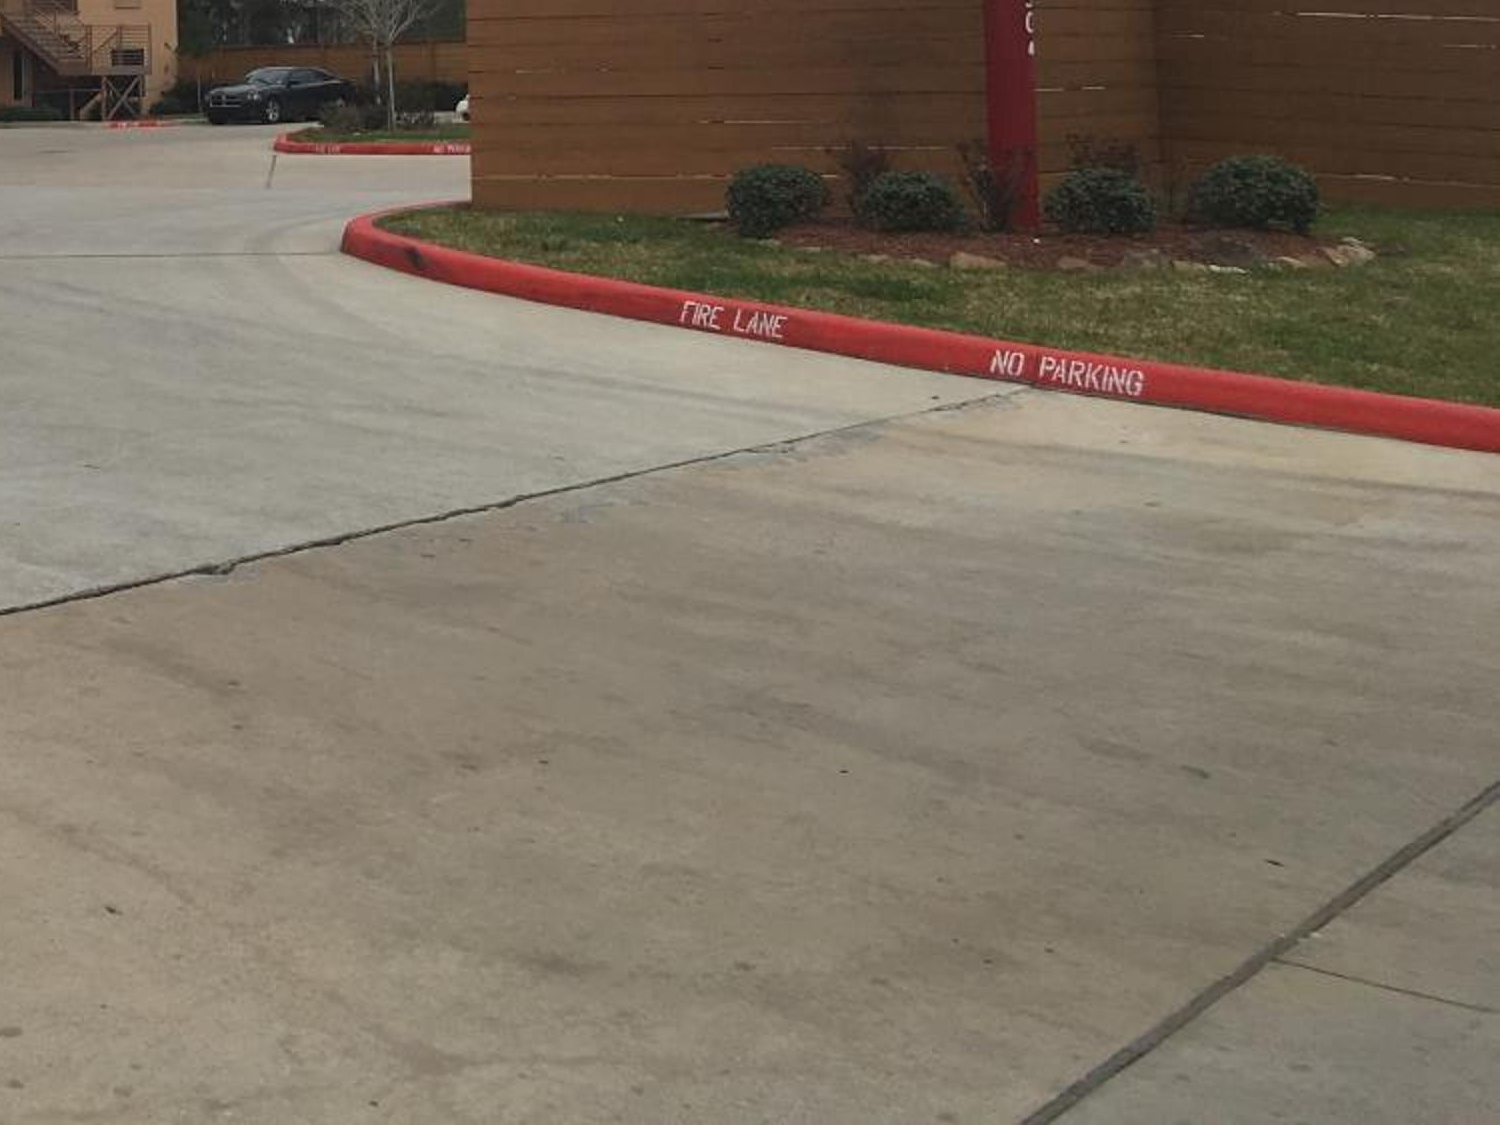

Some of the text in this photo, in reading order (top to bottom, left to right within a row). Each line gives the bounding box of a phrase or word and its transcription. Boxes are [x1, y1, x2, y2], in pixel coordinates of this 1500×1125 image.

[680, 300, 788, 339] FIRE LANE
[990, 349, 1144, 397] NO PARKING
